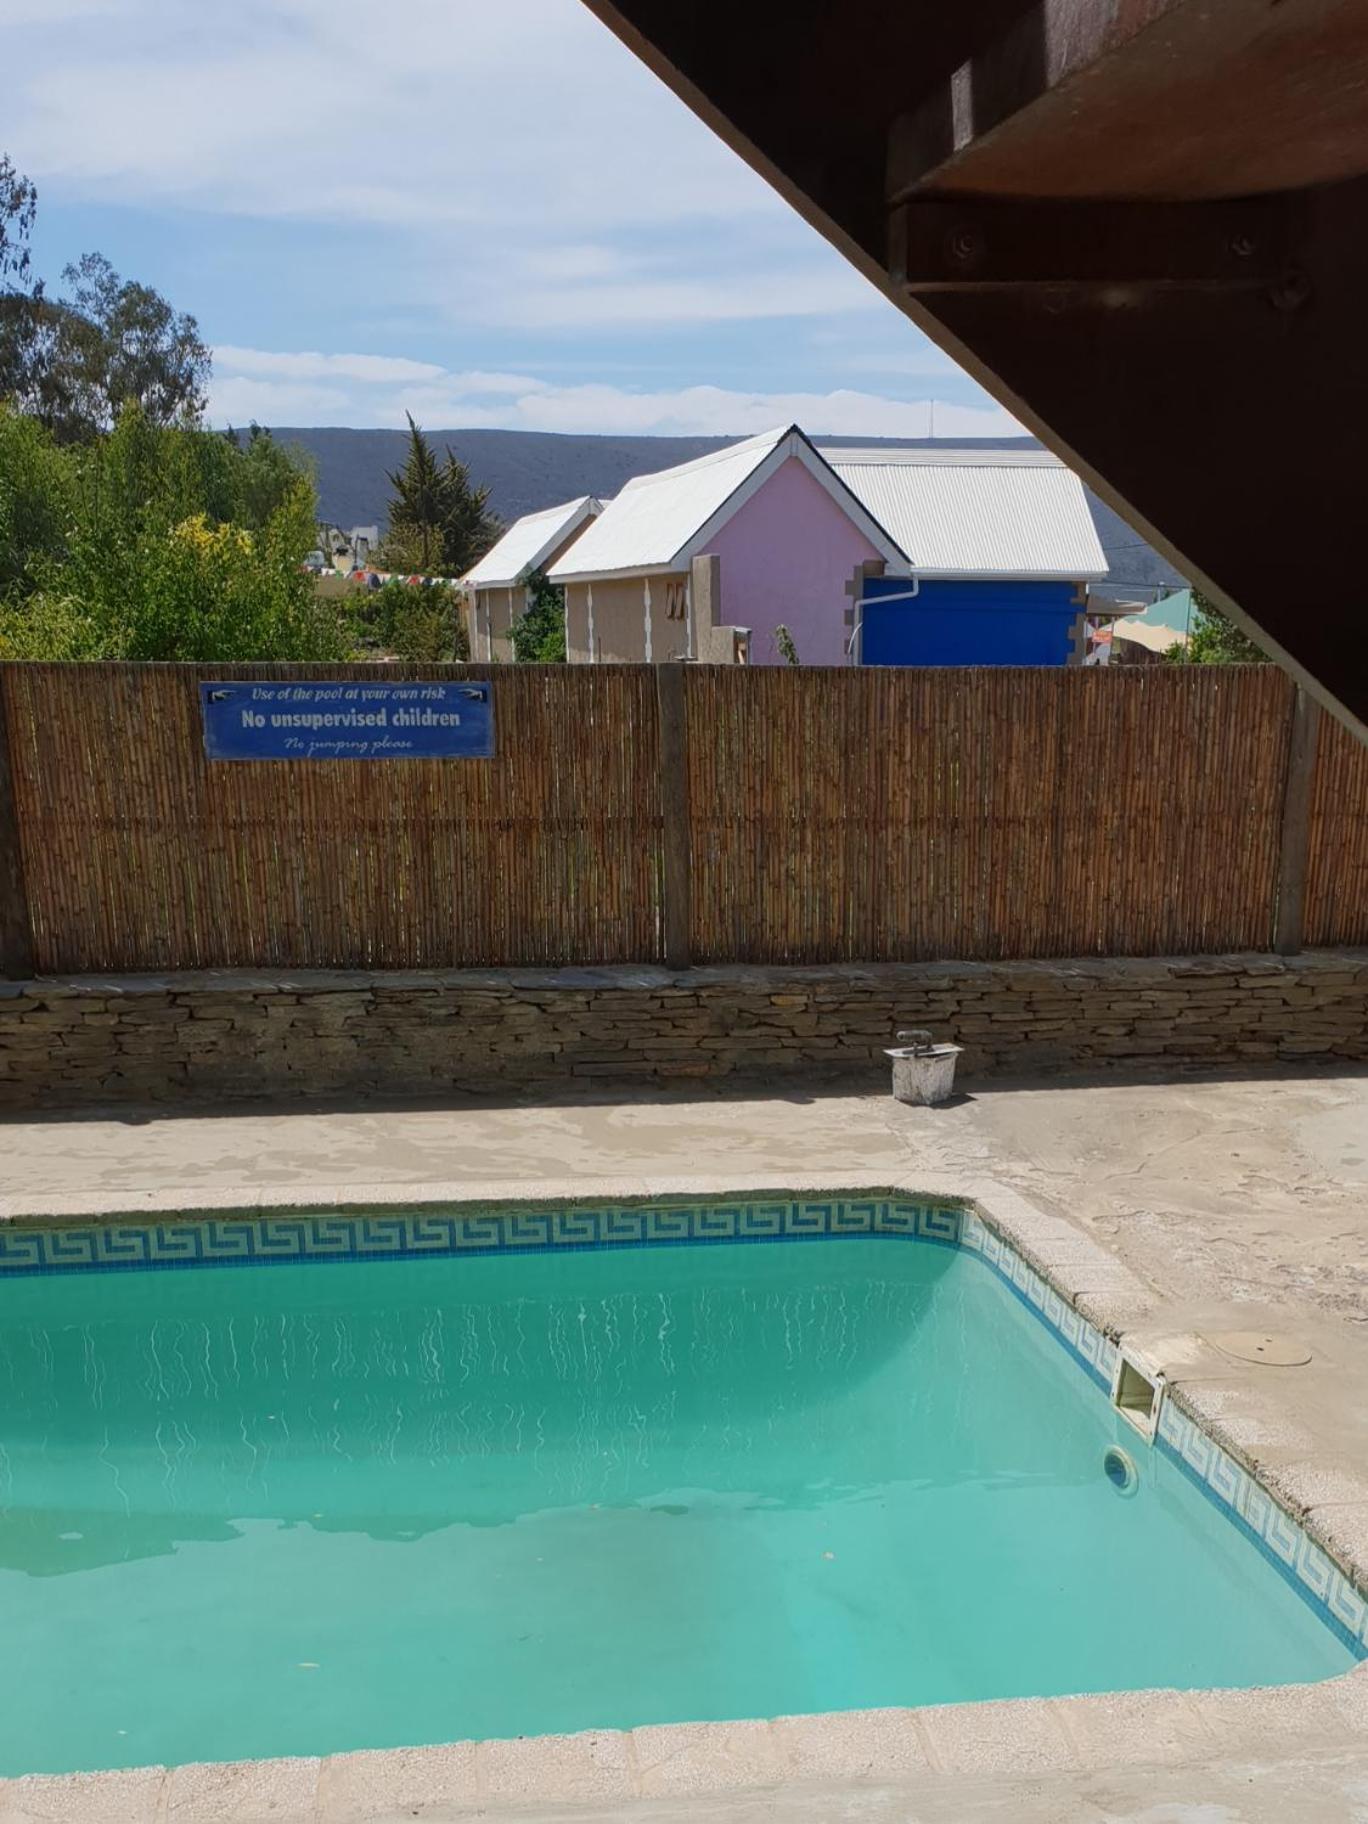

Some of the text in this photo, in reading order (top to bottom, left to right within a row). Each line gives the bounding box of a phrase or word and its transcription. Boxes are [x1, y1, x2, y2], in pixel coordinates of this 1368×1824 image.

[252, 686, 446, 702] Use of the pool at your own risk
[241, 707, 460, 730] No unsupervised children
[283, 737, 305, 749] No
[370, 735, 413, 754] please
